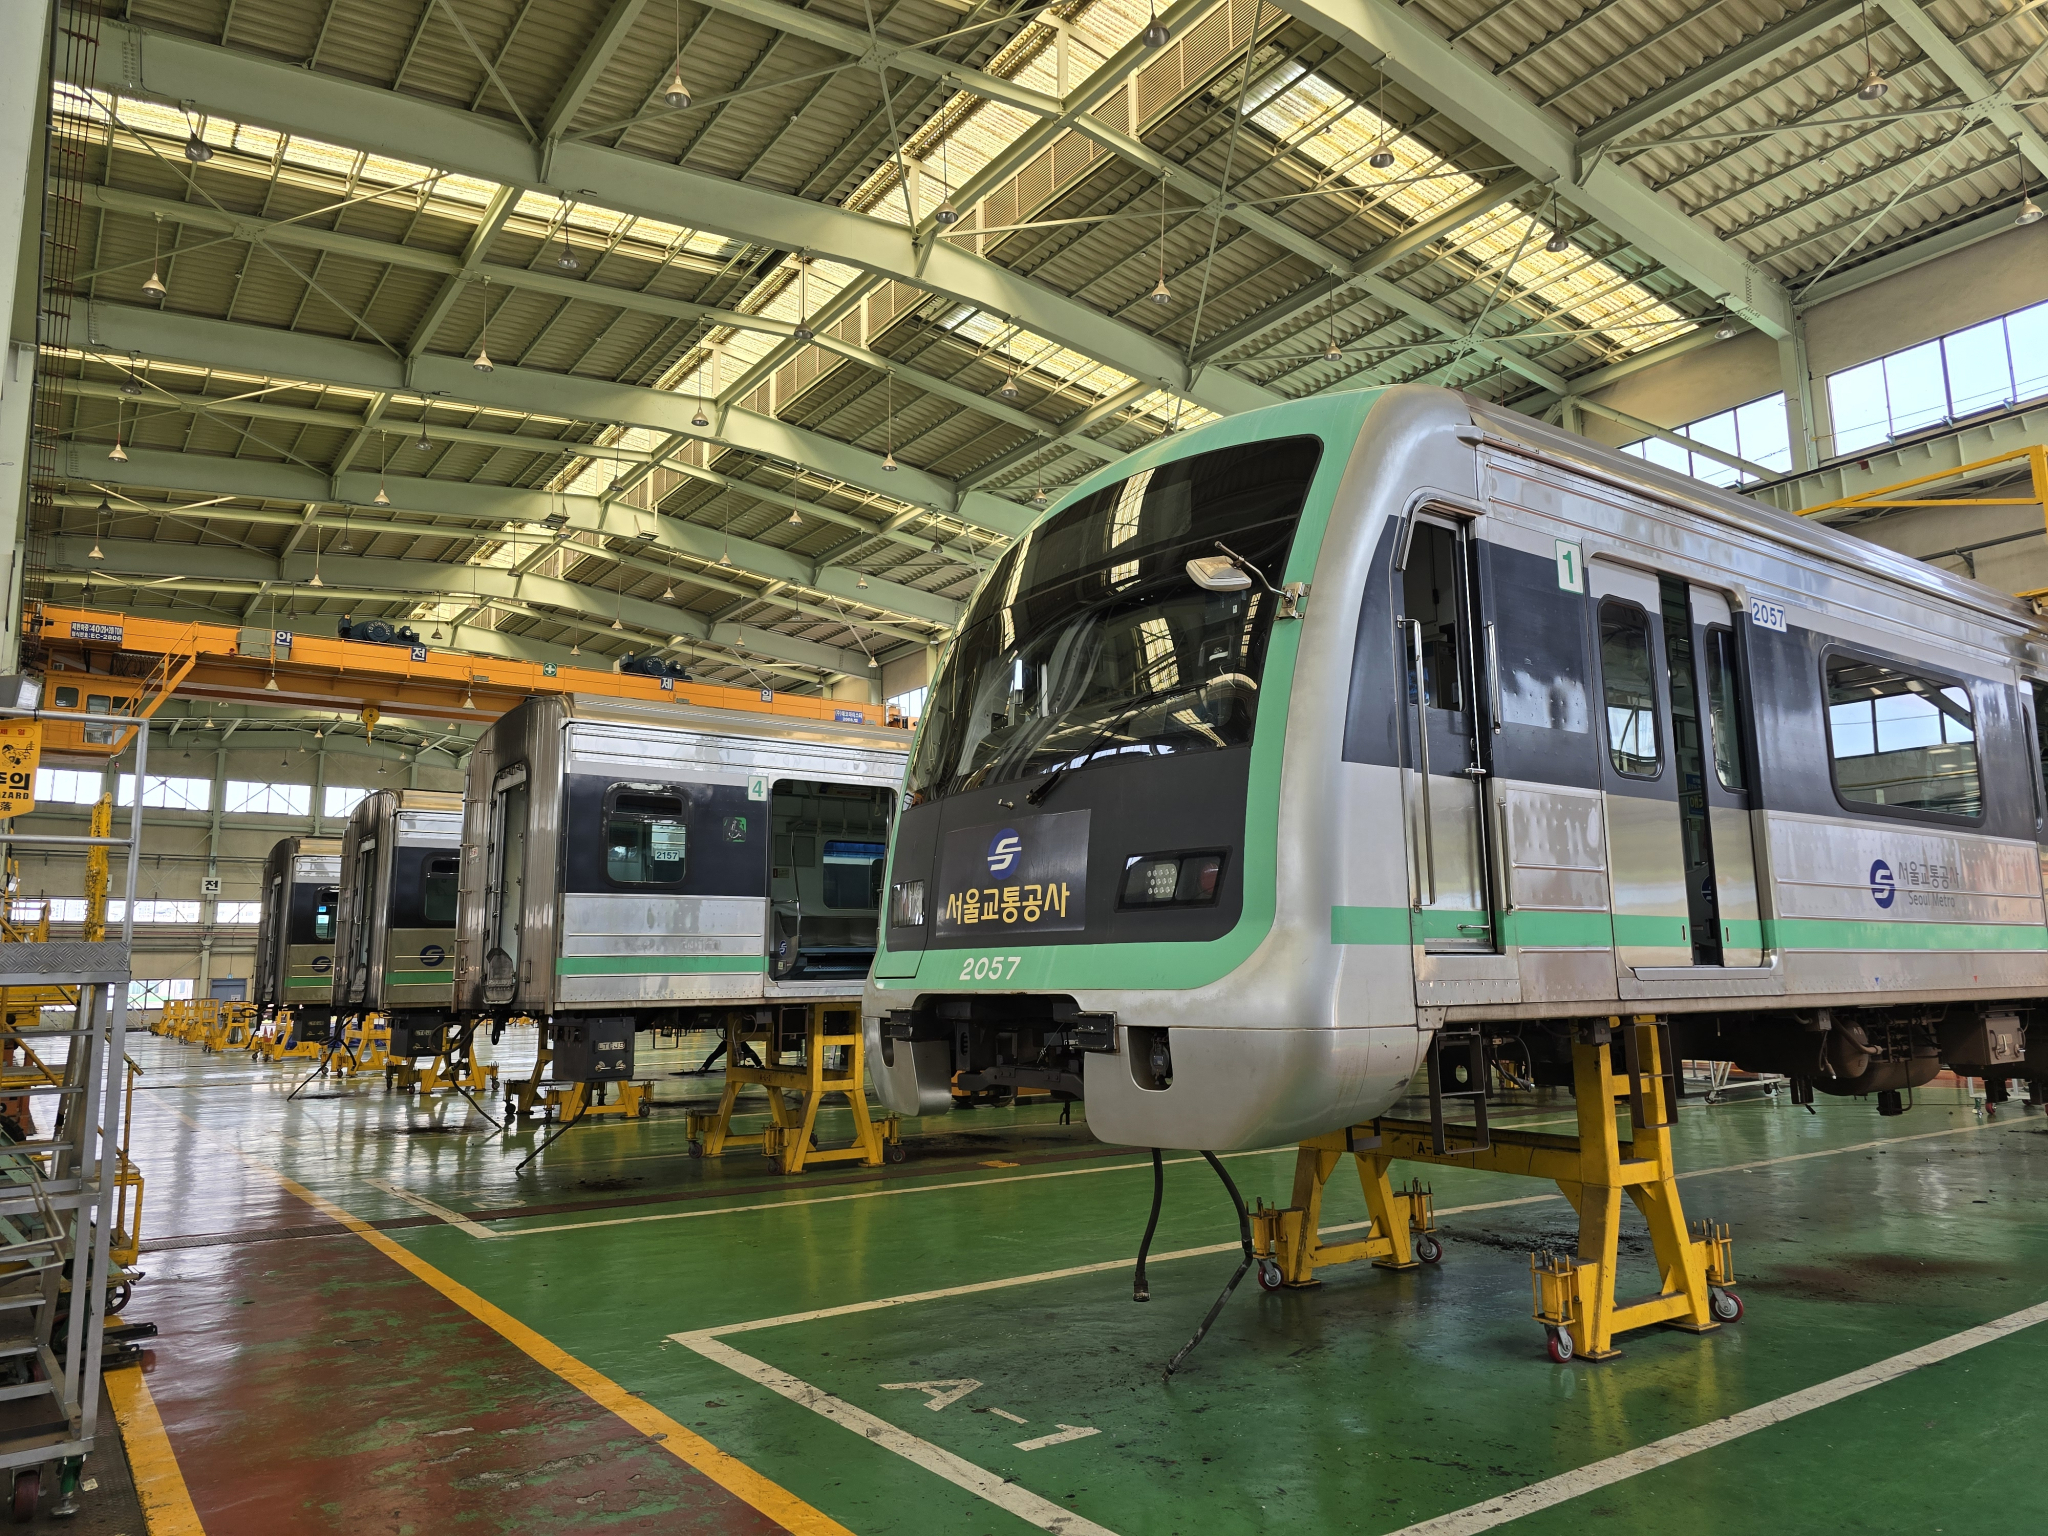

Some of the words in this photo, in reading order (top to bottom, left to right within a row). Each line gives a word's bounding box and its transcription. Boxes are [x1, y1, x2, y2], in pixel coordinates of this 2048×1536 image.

[1562, 550, 1574, 584] 1
[1753, 602, 1784, 628] 2057
[276, 631, 293, 646] 안
[412, 647, 426, 660] 전
[661, 677, 673, 690] 제
[0, 791, 29, 800] ZARD
[752, 780, 763, 798] 4
[656, 851, 678, 860] 2157
[205, 880, 219, 891] 전
[1898, 861, 1960, 889] 서울교통공사
[945, 882, 1070, 925] 서울교통공사
[1908, 890, 1931, 906] Seoul
[1932, 892, 1956, 908] Metro
[959, 956, 1022, 981] 2057
[878, 1377, 1103, 1452] A-1
